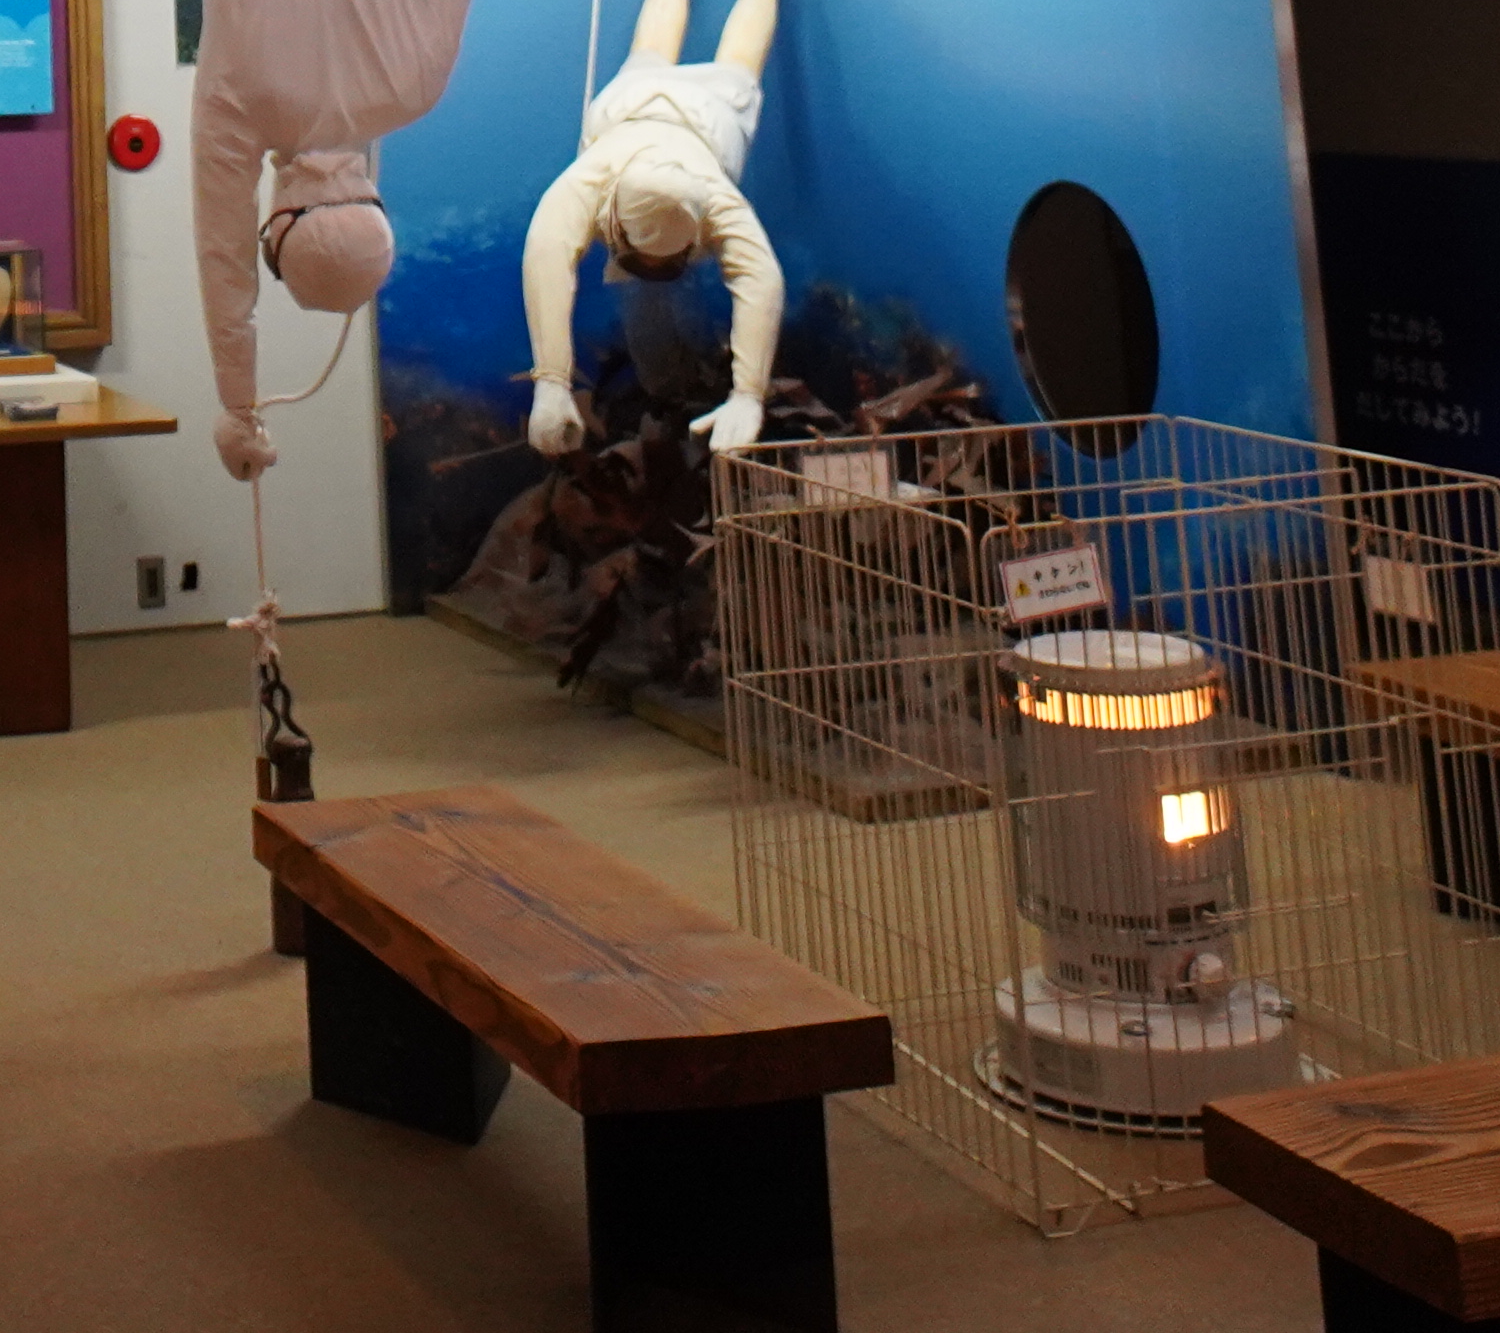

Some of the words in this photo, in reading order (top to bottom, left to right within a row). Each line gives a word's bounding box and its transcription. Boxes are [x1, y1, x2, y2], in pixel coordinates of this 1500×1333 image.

[1369, 312, 1443, 347] ここから
[1373, 354, 1448, 391] からだを
